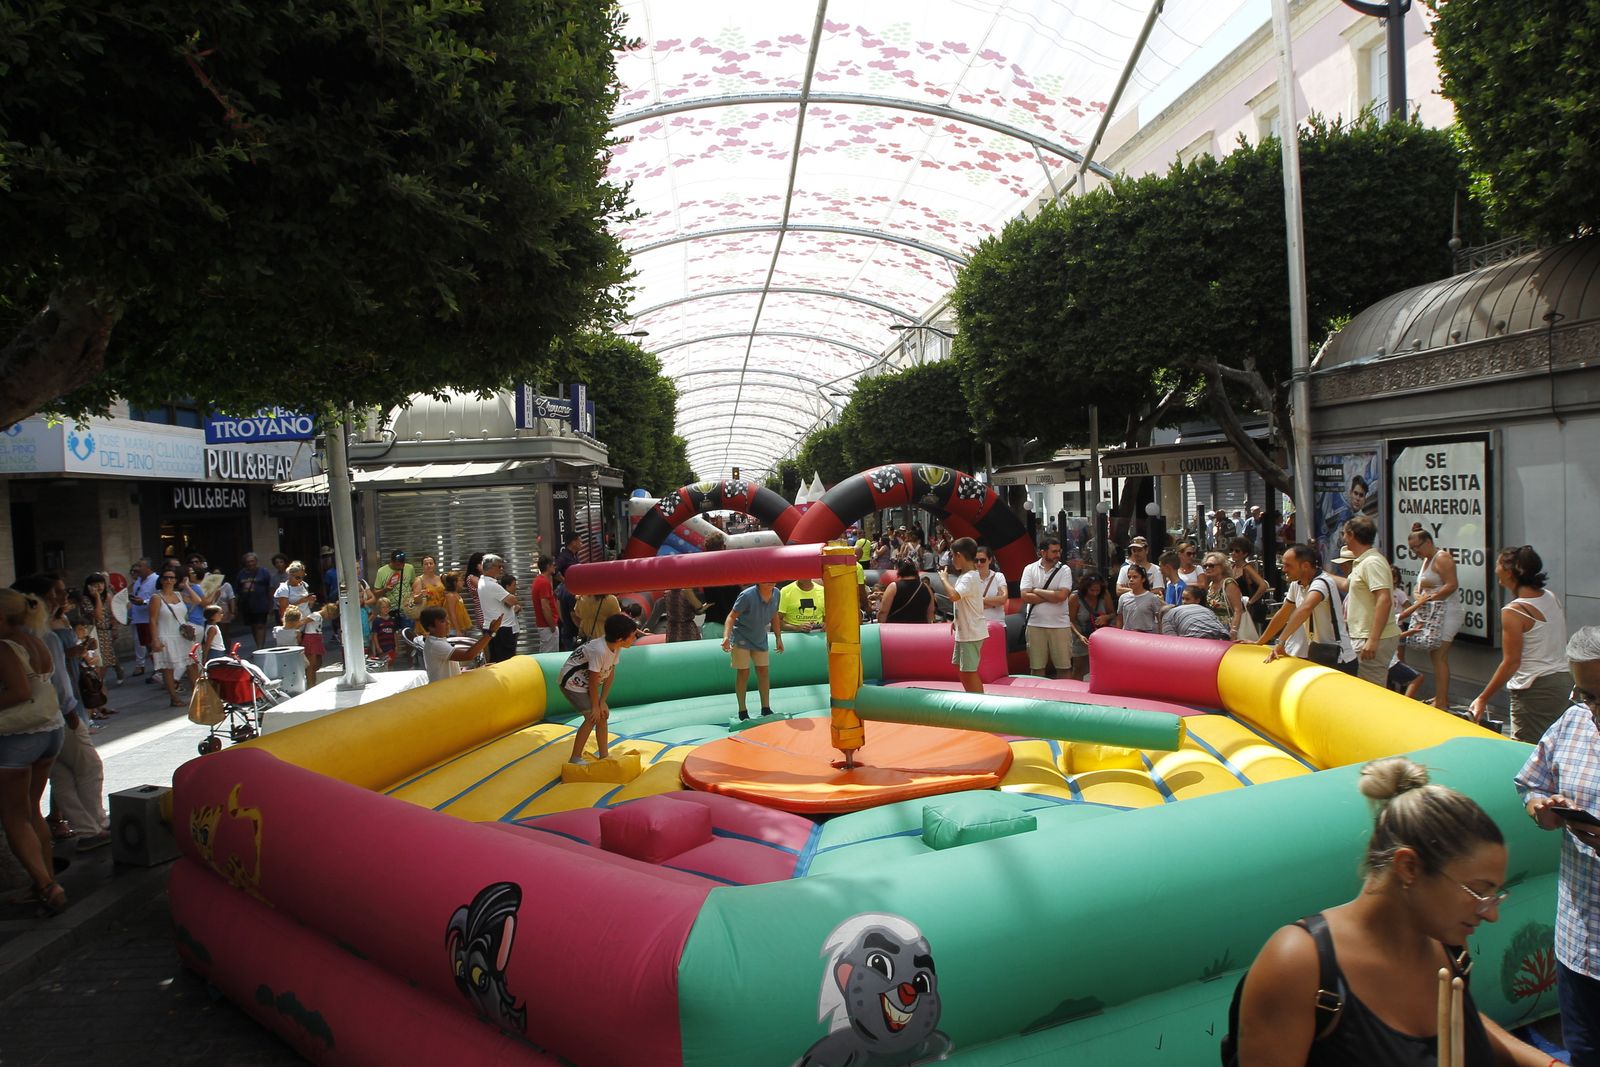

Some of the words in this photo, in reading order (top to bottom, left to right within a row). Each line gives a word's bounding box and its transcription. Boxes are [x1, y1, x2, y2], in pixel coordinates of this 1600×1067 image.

[211, 416, 314, 439] TROYANO
[99, 450, 125, 468] DEL
[207, 449, 294, 480] PULL&BEAR
[1107, 461, 1150, 476] CAFETERIA
[1179, 455, 1230, 473] COIMBRA
[1425, 452, 1447, 469] SE
[1398, 474, 1481, 491] NECESITA
[174, 488, 247, 509] PULL&BEAR
[1398, 498, 1482, 515] CAMARERO/A
[1430, 523, 1443, 538] Y
